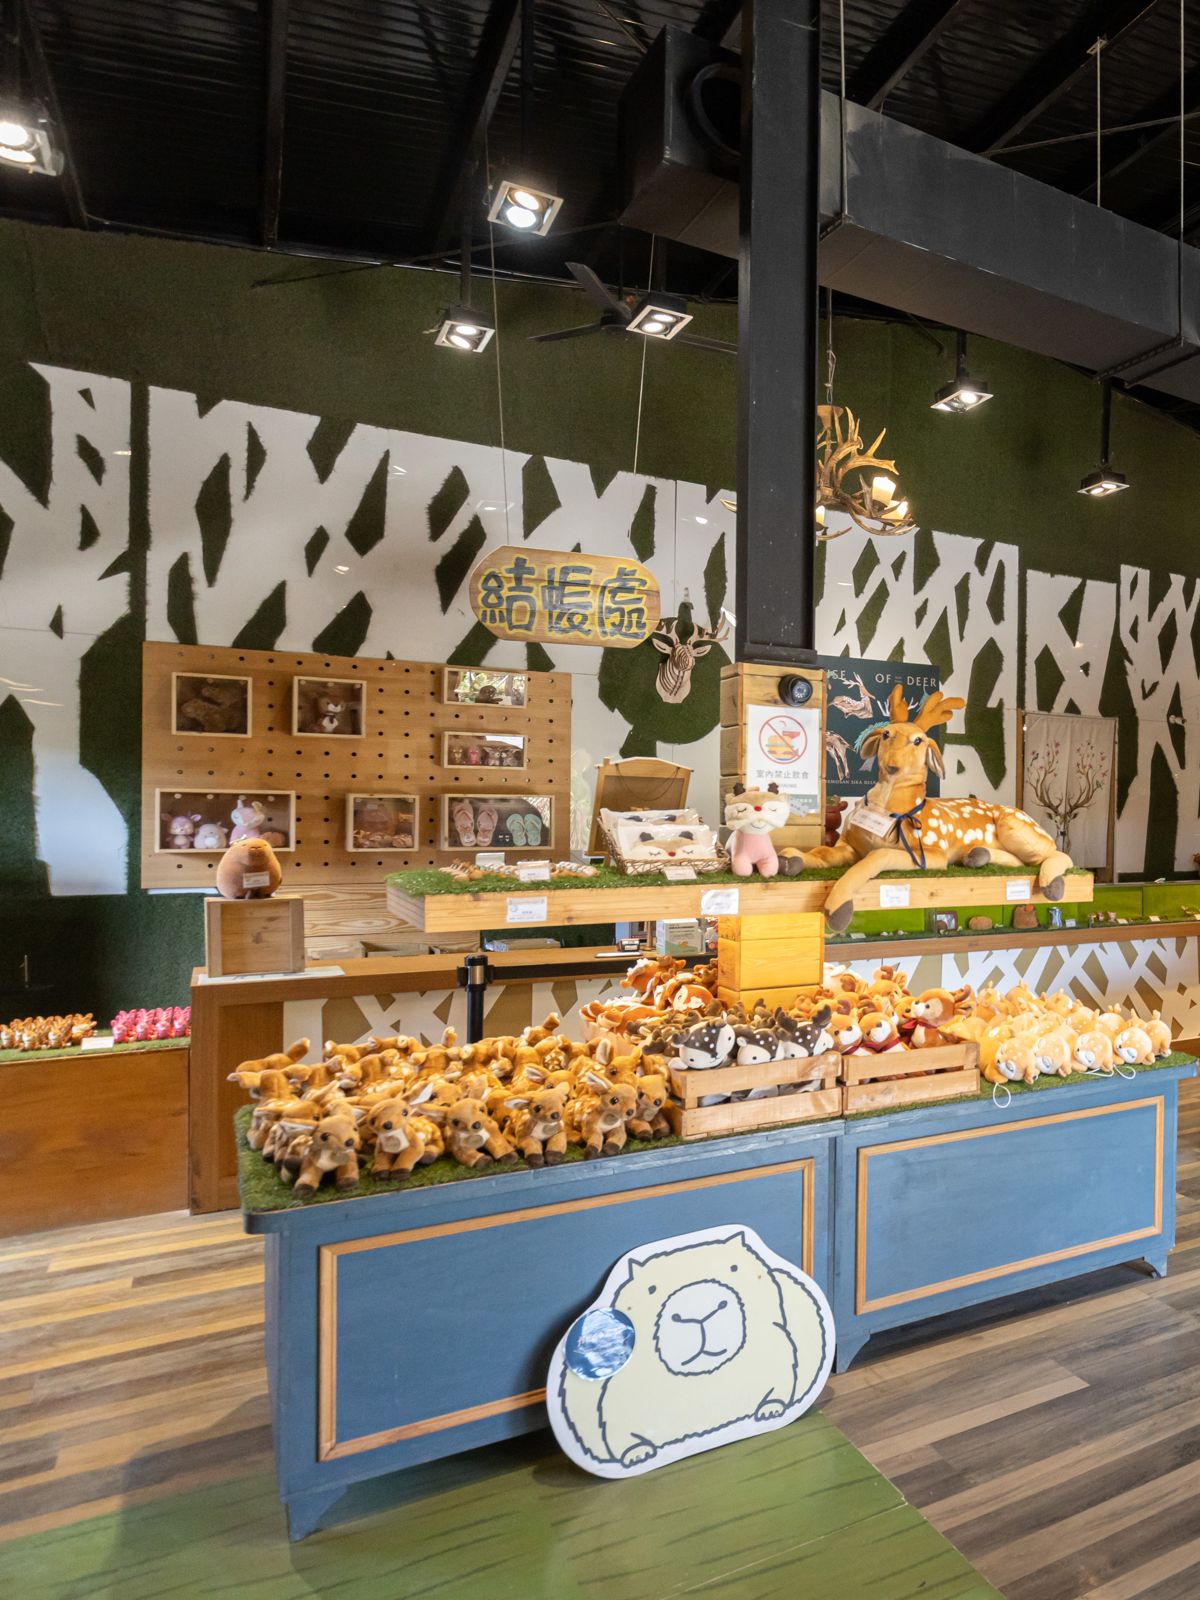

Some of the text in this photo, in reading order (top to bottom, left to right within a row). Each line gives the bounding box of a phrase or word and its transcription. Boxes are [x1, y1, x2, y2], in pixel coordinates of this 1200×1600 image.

[480, 555, 648, 639] 結帳處
[874, 673, 892, 684] OF
[906, 676, 937, 687] DEER
